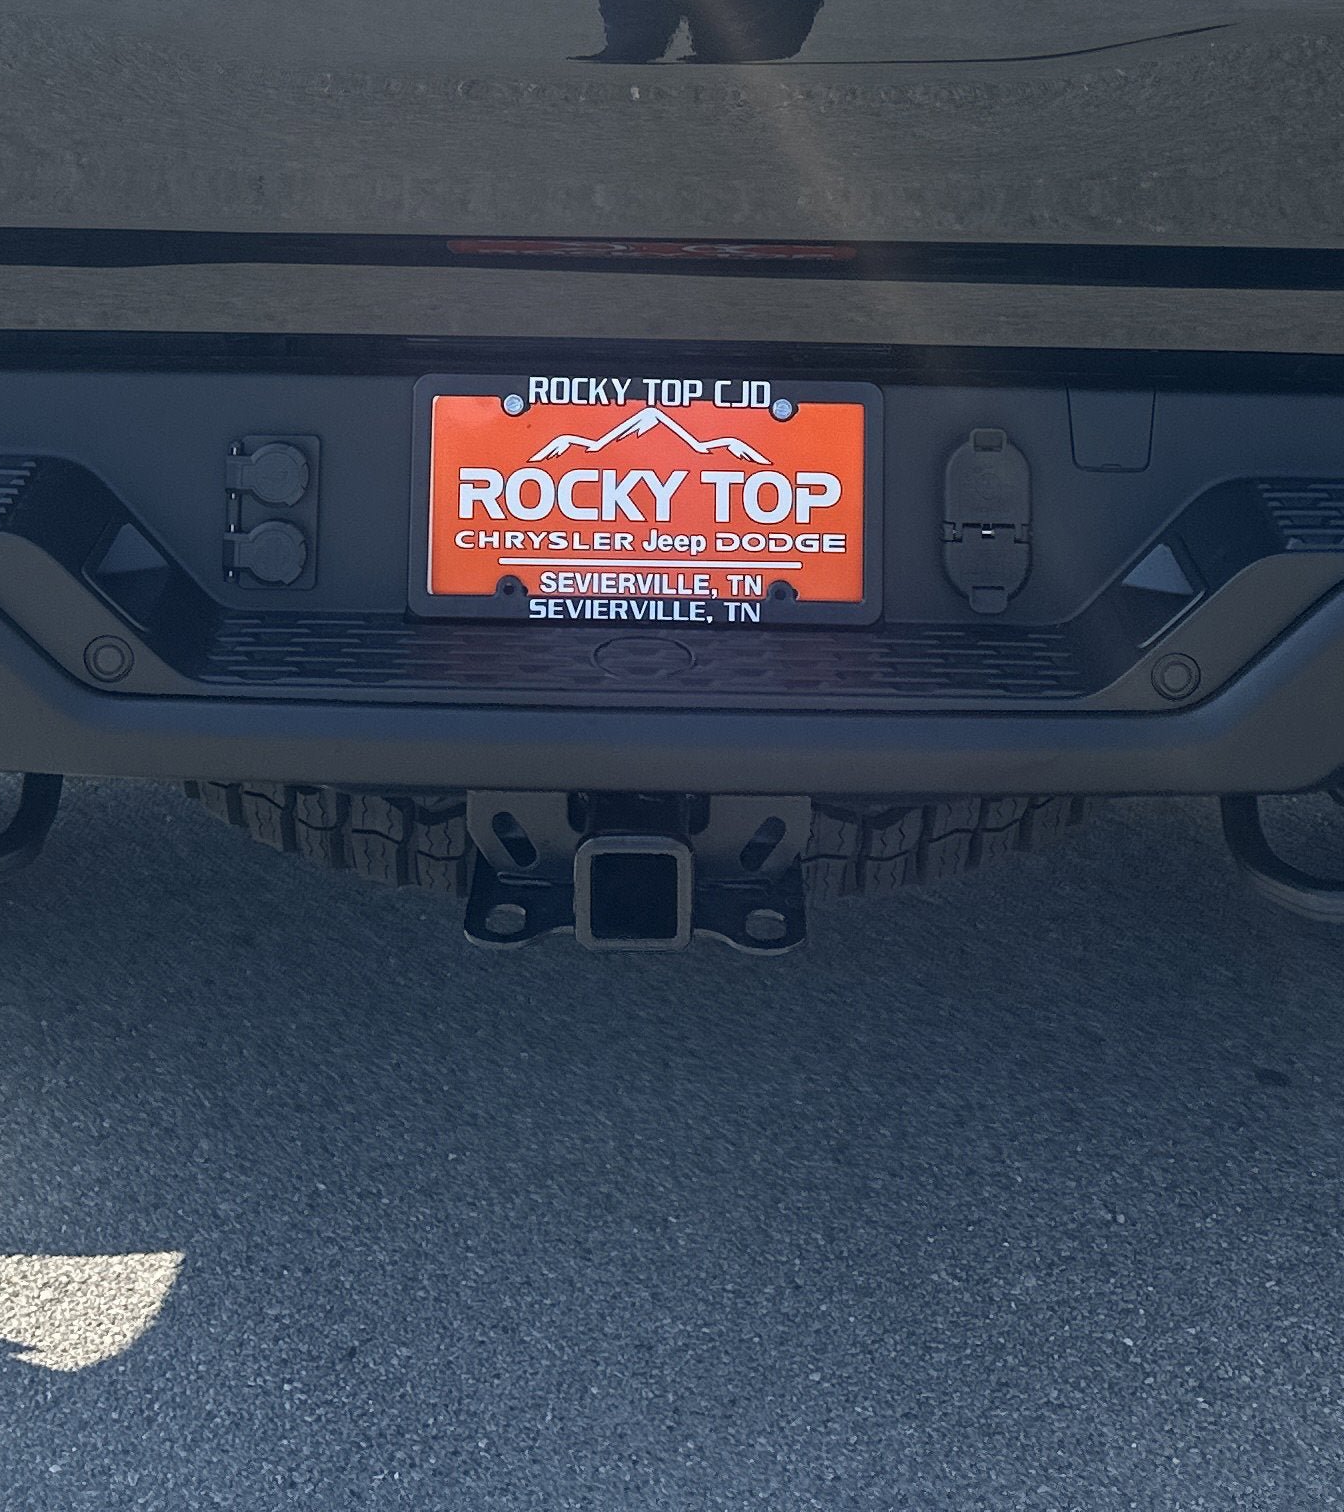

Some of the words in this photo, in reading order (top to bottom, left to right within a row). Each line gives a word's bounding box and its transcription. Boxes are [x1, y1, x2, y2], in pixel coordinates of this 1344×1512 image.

[528, 376, 632, 405] ROCKY
[642, 378, 703, 407] TOP
[714, 380, 771, 409] CJD
[458, 467, 690, 522] ROCKY
[700, 470, 843, 525] TOP
[454, 530, 636, 552] CHRYSLER
[641, 528, 708, 556] Jeep
[714, 532, 847, 554] DODGE
[539, 571, 718, 600] SEVIERVILLE,
[726, 573, 764, 597] TN
[529, 599, 713, 624] SEVIERVILLE,
[723, 601, 761, 623] TN
